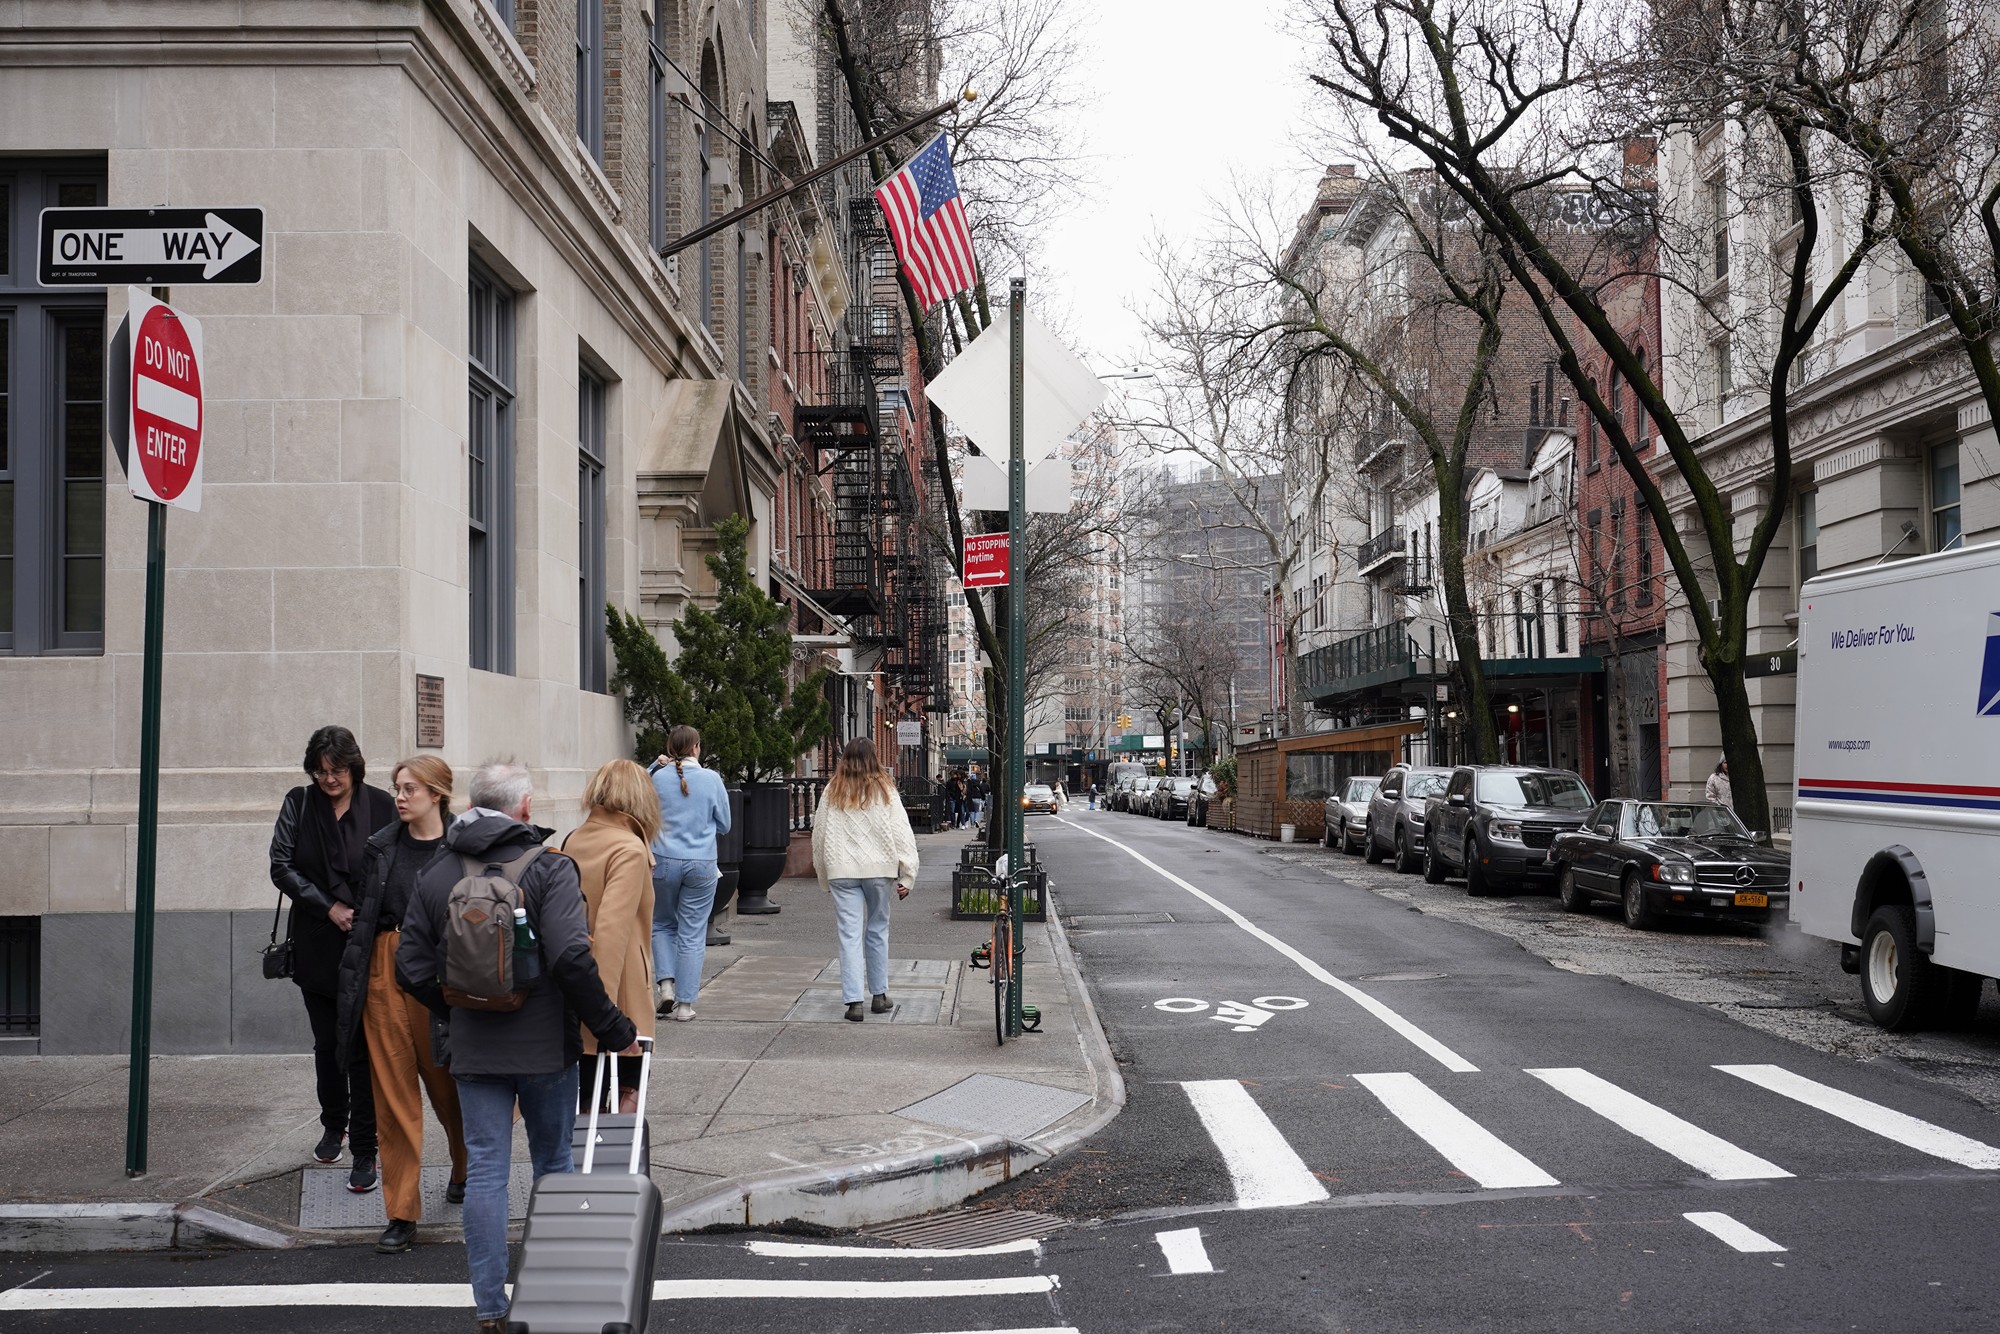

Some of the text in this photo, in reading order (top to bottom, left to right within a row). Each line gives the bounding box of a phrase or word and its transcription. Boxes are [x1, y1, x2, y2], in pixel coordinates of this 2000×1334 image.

[60, 231, 233, 261] ONE WAY
[145, 335, 191, 382] DO NOT
[146, 426, 187, 467] ENTER
[966, 538, 1010, 552] NO STOPPING
[966, 552, 994, 565] Anytime
[1831, 623, 1915, 650] We Deliver For You.
[1770, 656, 1781, 672] 30
[1828, 739, 1871, 753] www.usps.com
